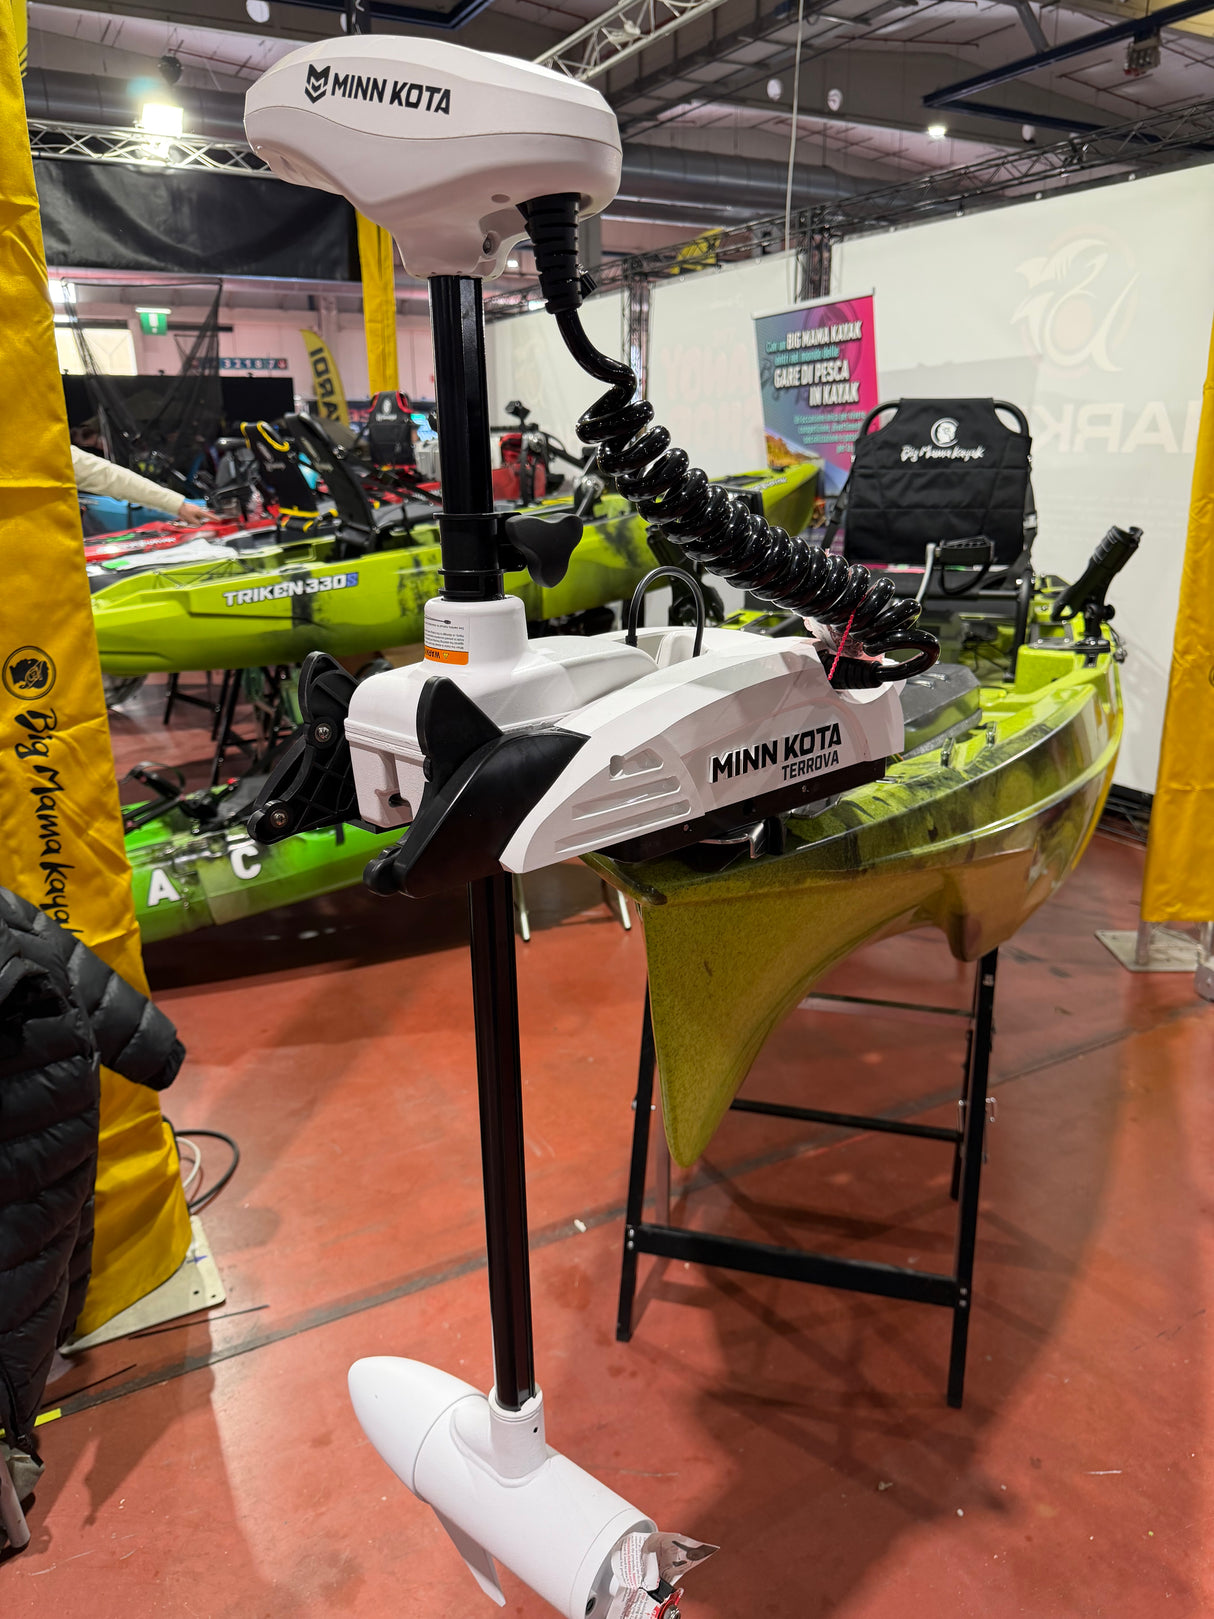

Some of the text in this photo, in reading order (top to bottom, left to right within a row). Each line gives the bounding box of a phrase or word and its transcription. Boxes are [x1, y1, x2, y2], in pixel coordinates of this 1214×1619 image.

[331, 72, 451, 115] MINN KOTA
[786, 331, 801, 350] BIG
[801, 326, 830, 348] MAMA
[830, 320, 863, 343] KAYAK
[773, 359, 850, 389] GARE DI PESCA
[809, 381, 860, 407] IN KAYAK
[709, 722, 842, 784] MINN KOTA
[781, 750, 840, 781] TERROVA
[14, 707, 84, 934] Big Mama kaya
